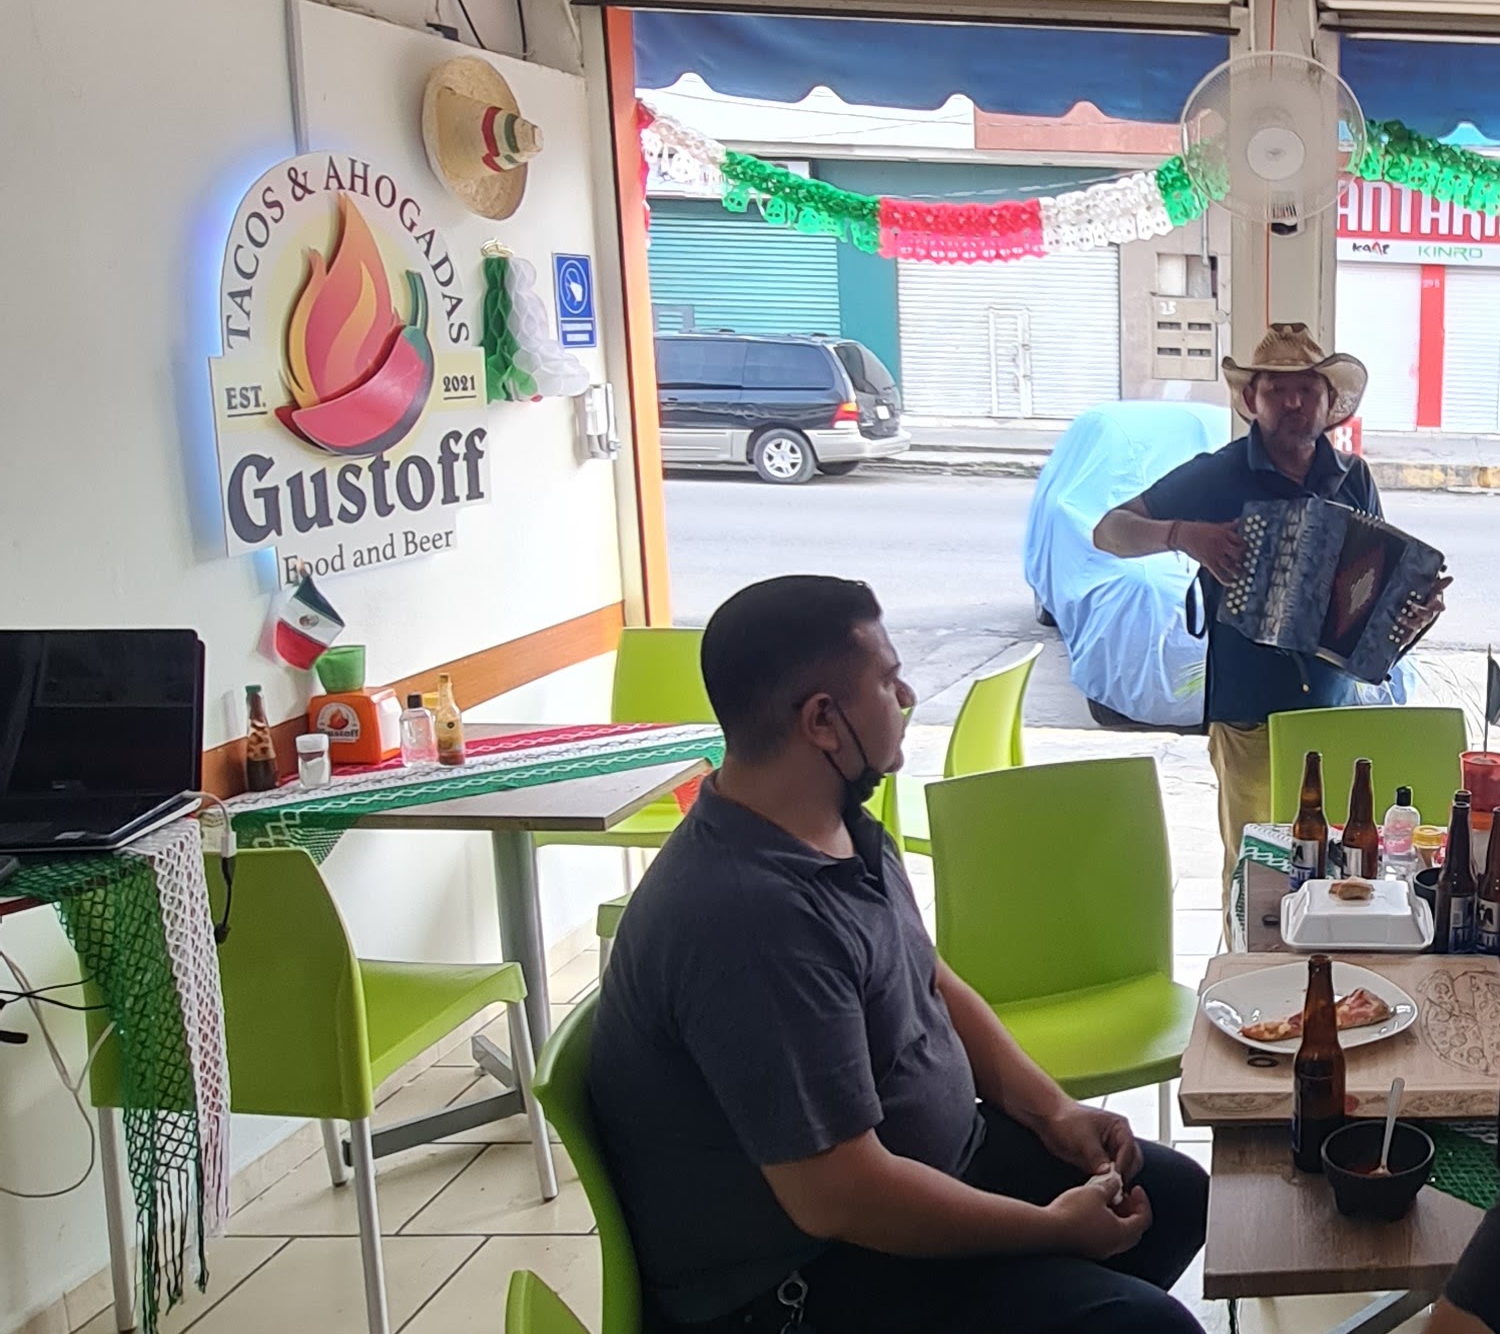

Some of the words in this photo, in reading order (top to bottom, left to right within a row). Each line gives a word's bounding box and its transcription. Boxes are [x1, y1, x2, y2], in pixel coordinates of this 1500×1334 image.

[226, 187, 285, 349] TACOS
[288, 167, 315, 201] &
[324, 156, 469, 344] AHOGADAS
[1417, 245, 1483, 260] KINRO
[225, 385, 267, 410] EST.
[443, 375, 476, 393] 2021
[227, 427, 487, 544] Gustoff
[283, 544, 345, 585] Food
[353, 533, 397, 568] and
[403, 530, 454, 556] Beer
